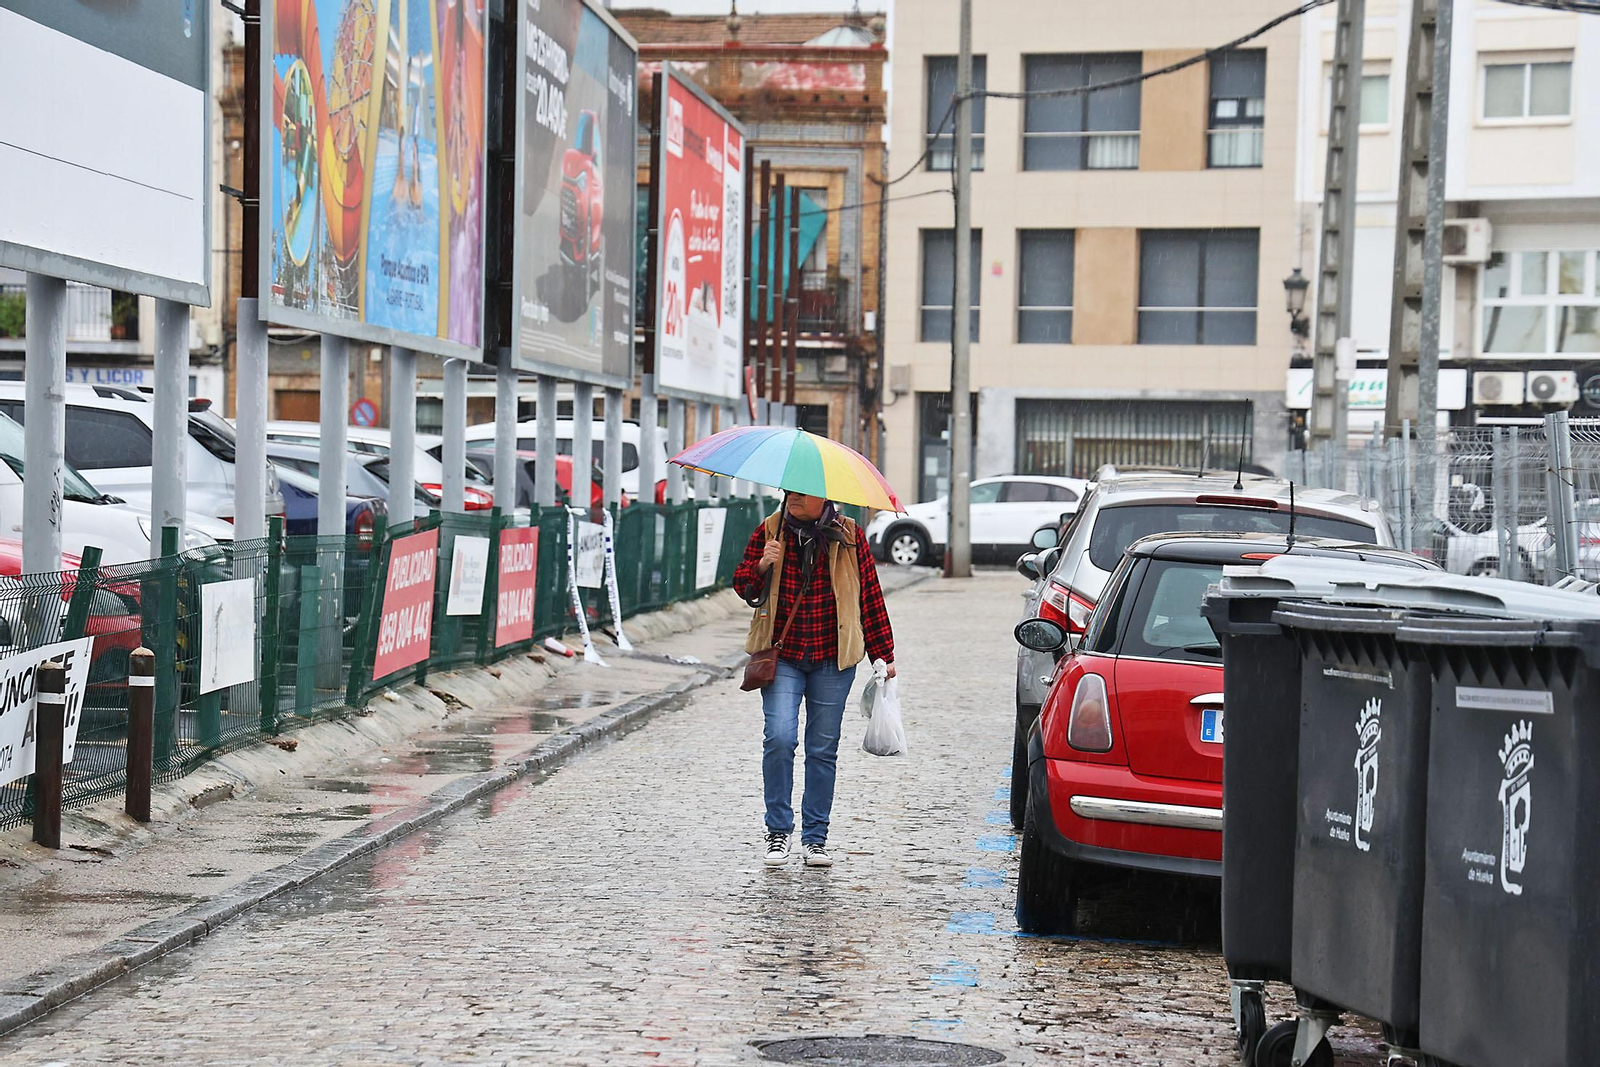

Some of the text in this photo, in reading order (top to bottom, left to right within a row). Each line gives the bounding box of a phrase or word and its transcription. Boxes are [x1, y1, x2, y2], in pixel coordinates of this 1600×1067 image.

[389, 548, 434, 592] PUBLICIDAD
[379, 611, 398, 657] 959
[396, 605, 415, 651] 804
[1205, 728, 1213, 736] E
[1325, 807, 1352, 825] Ayuntamiento
[1329, 825, 1350, 842] de Huelva
[1462, 848, 1496, 866] Ayuntamiento
[1468, 867, 1494, 885] de Huelva
